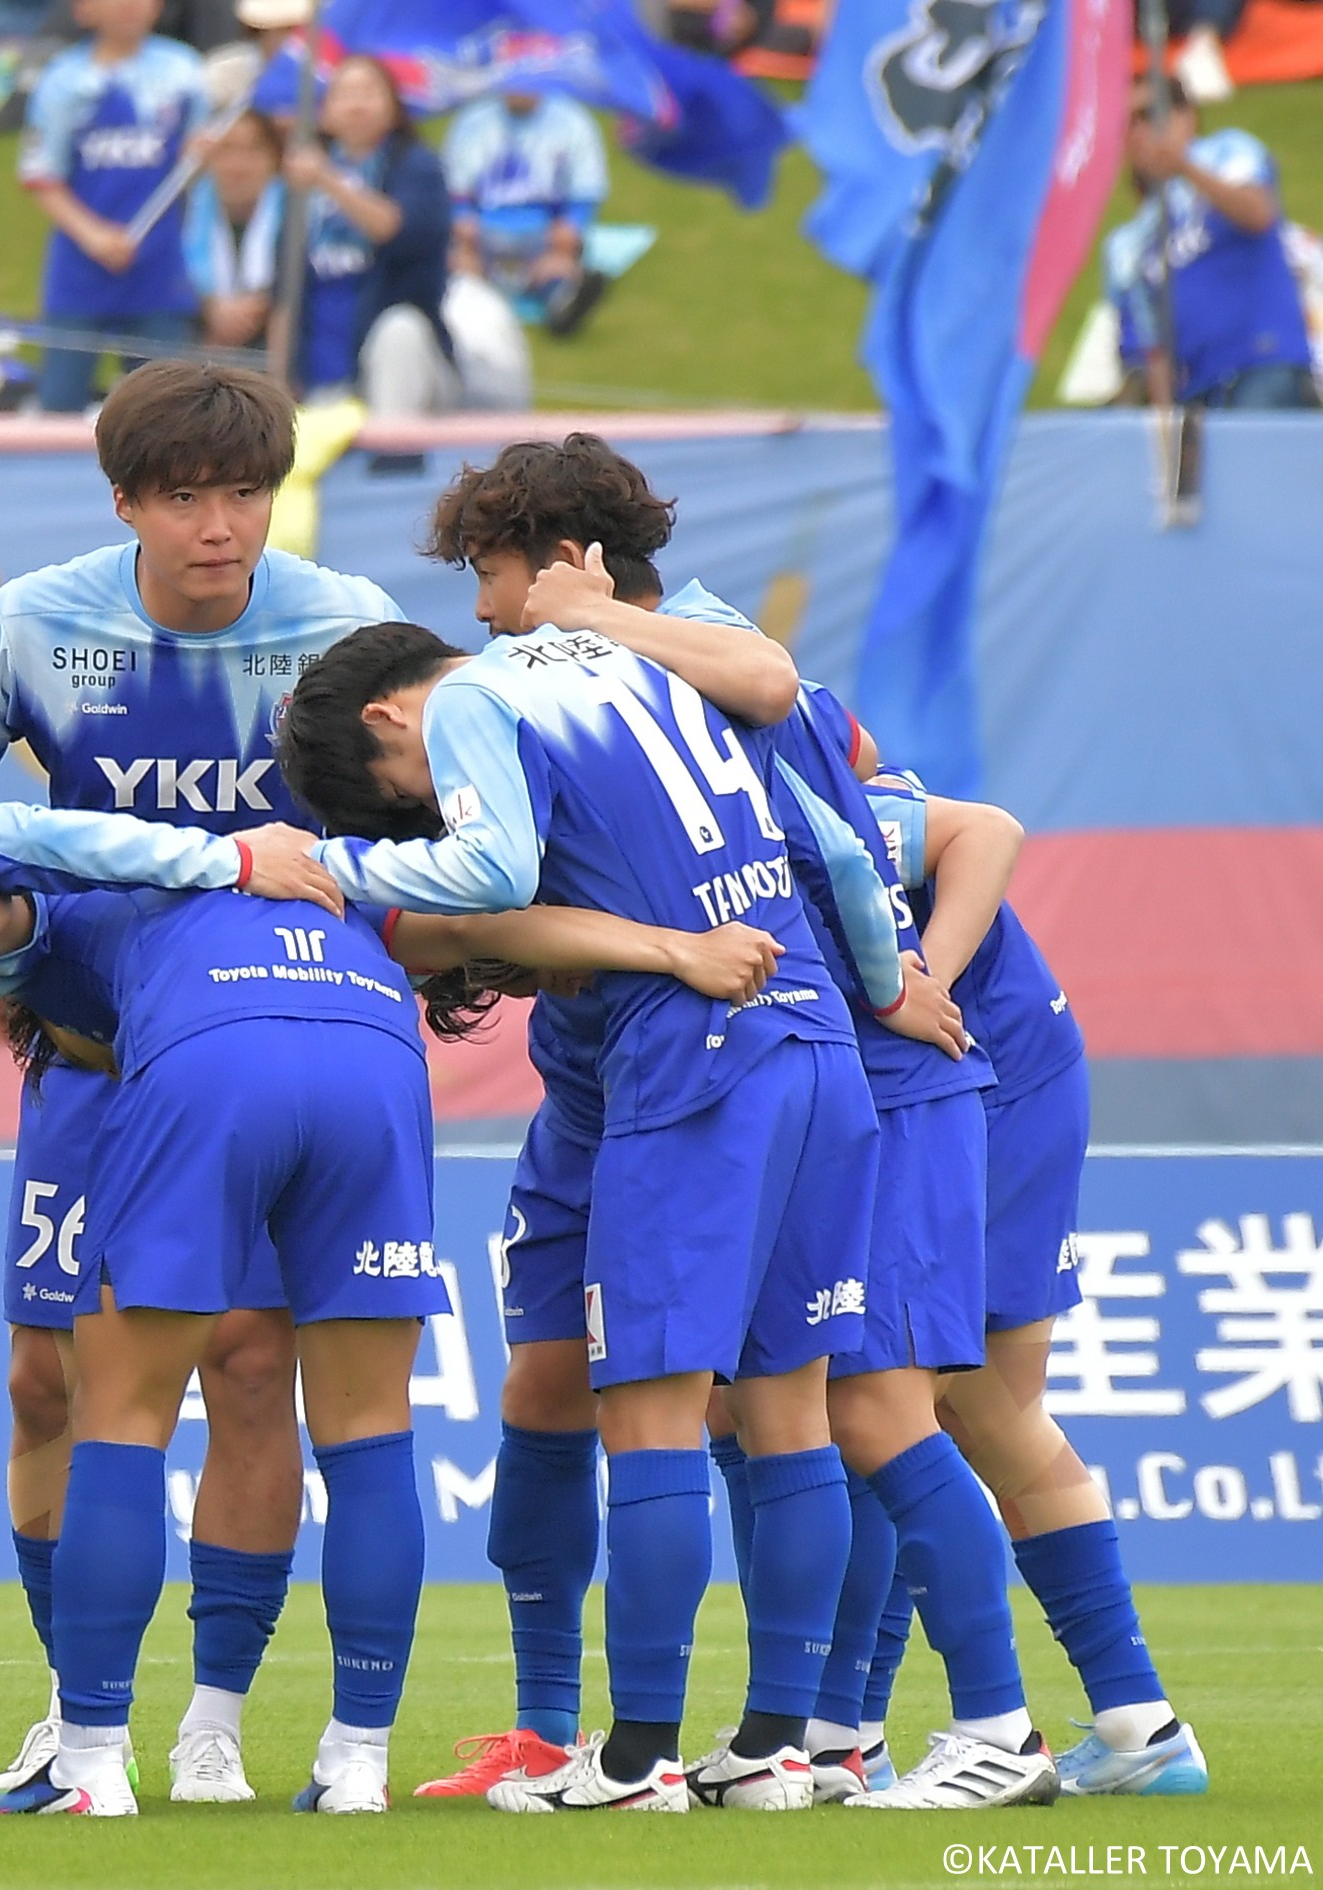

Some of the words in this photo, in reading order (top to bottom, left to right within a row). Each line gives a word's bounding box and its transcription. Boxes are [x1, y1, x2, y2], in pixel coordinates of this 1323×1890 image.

[52, 646, 137, 672] SHOEI
[71, 673, 116, 689] group
[81, 702, 128, 716] Goldwin
[592, 668, 787, 856] 14
[93, 756, 276, 814] YKK
[208, 966, 269, 983] Toyota
[272, 964, 344, 985] Mobility
[346, 970, 403, 1003] Toyama
